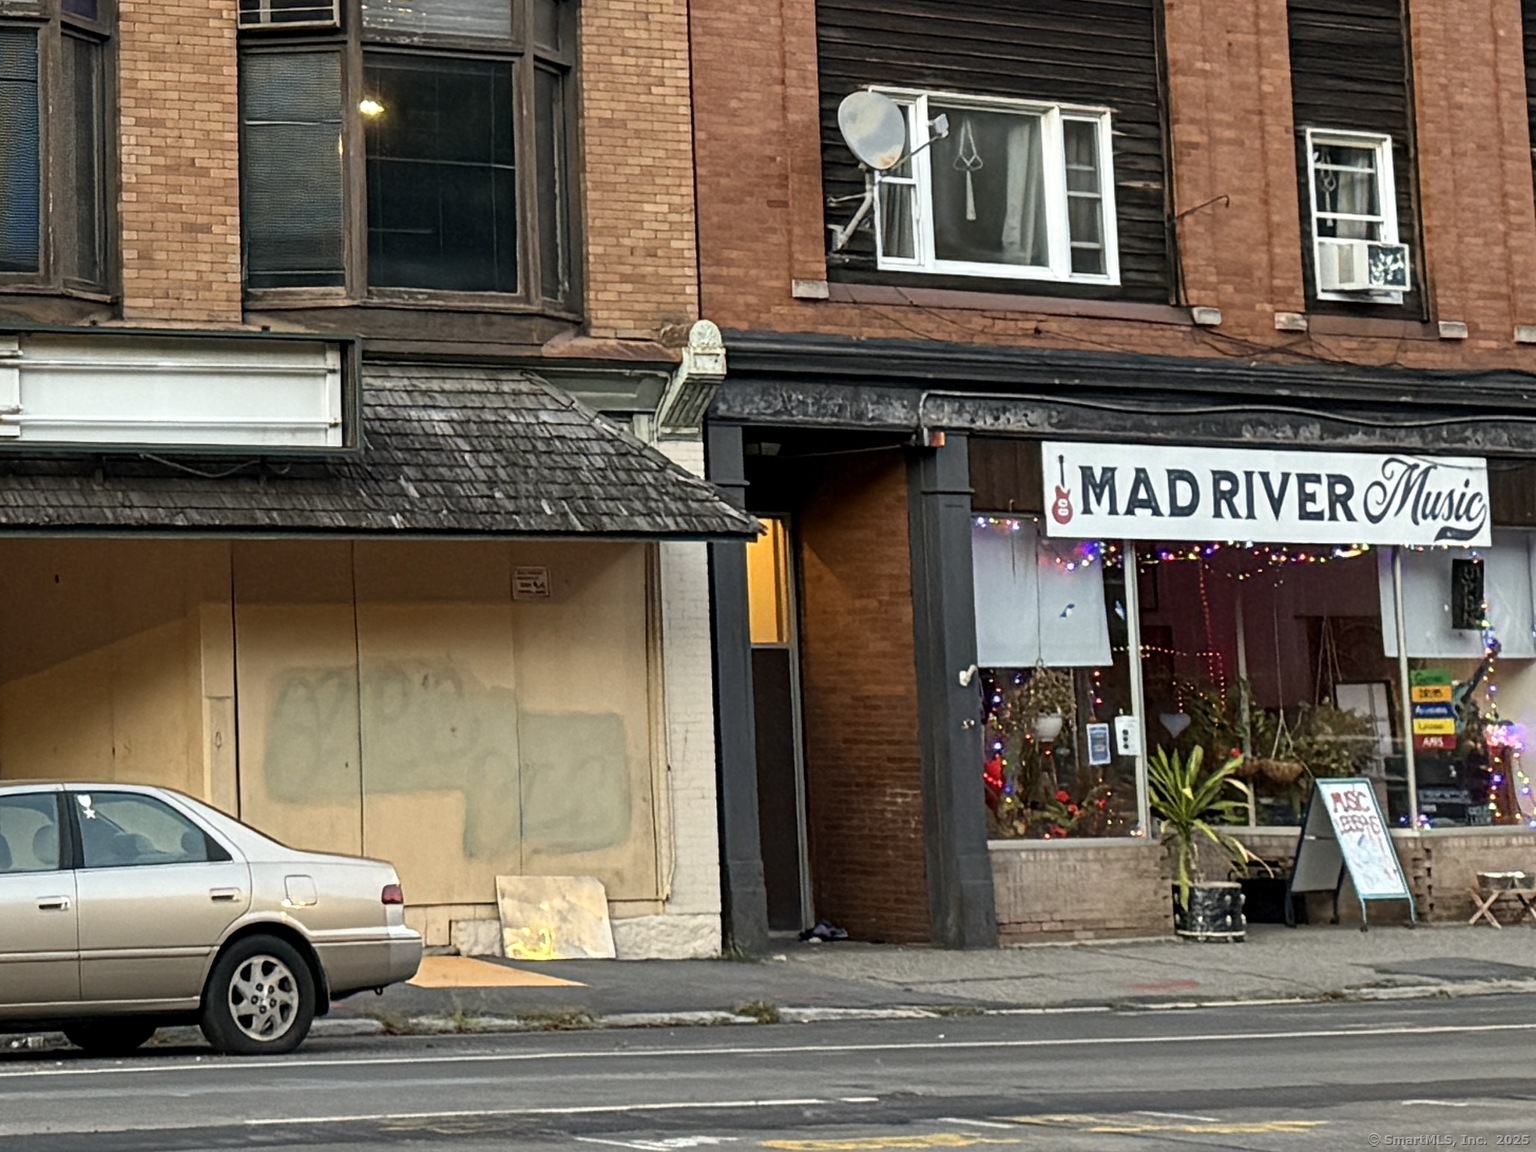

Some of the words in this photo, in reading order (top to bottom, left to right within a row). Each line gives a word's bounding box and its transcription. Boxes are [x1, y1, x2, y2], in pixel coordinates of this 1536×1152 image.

[1078, 465, 1201, 518] MAD
[1210, 469, 1358, 522] RIVER
[1363, 457, 1488, 541] Music
